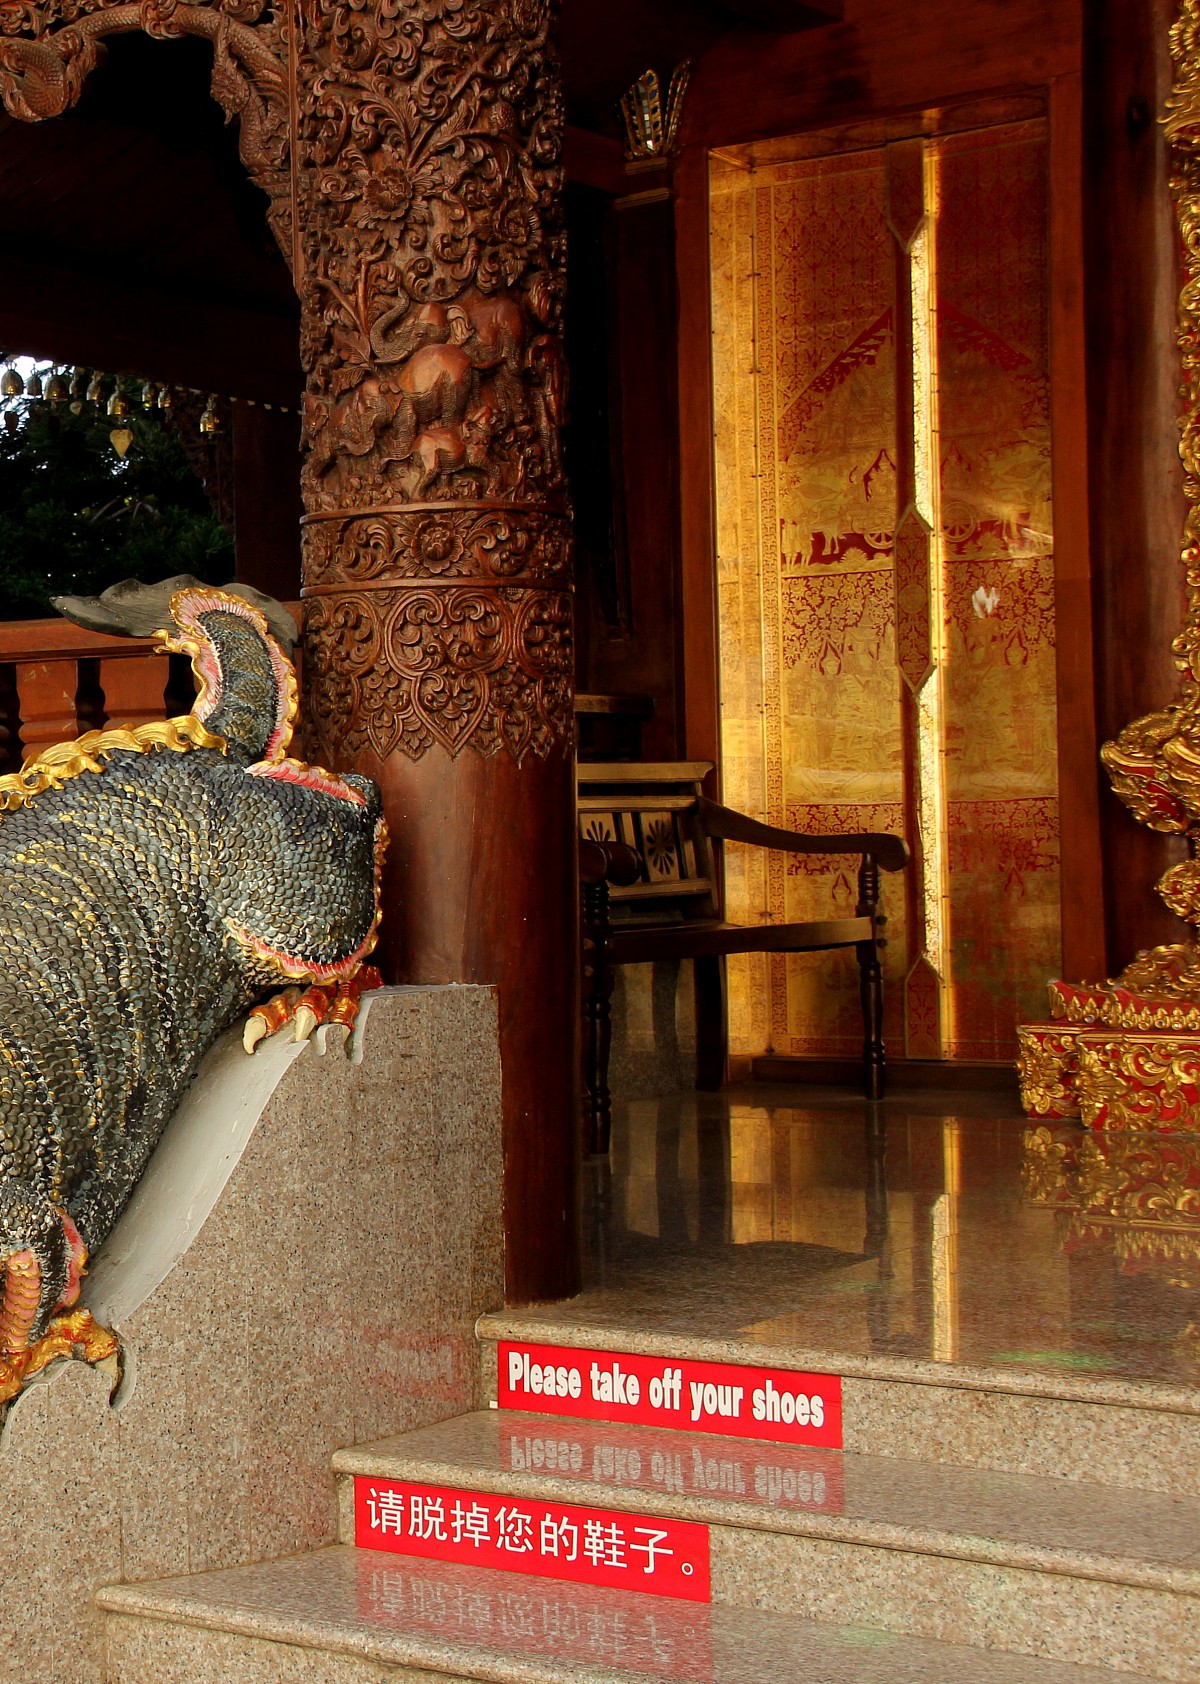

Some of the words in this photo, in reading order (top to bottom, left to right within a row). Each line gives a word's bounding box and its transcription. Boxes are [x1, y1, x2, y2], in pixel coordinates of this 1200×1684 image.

[508, 1351, 582, 1399] Please
[589, 1362, 640, 1405] take
[649, 1367, 682, 1411] off
[689, 1381, 744, 1422] your
[752, 1379, 825, 1428] shoes
[366, 1487, 694, 1576] 请脱掉您的鞋子。
